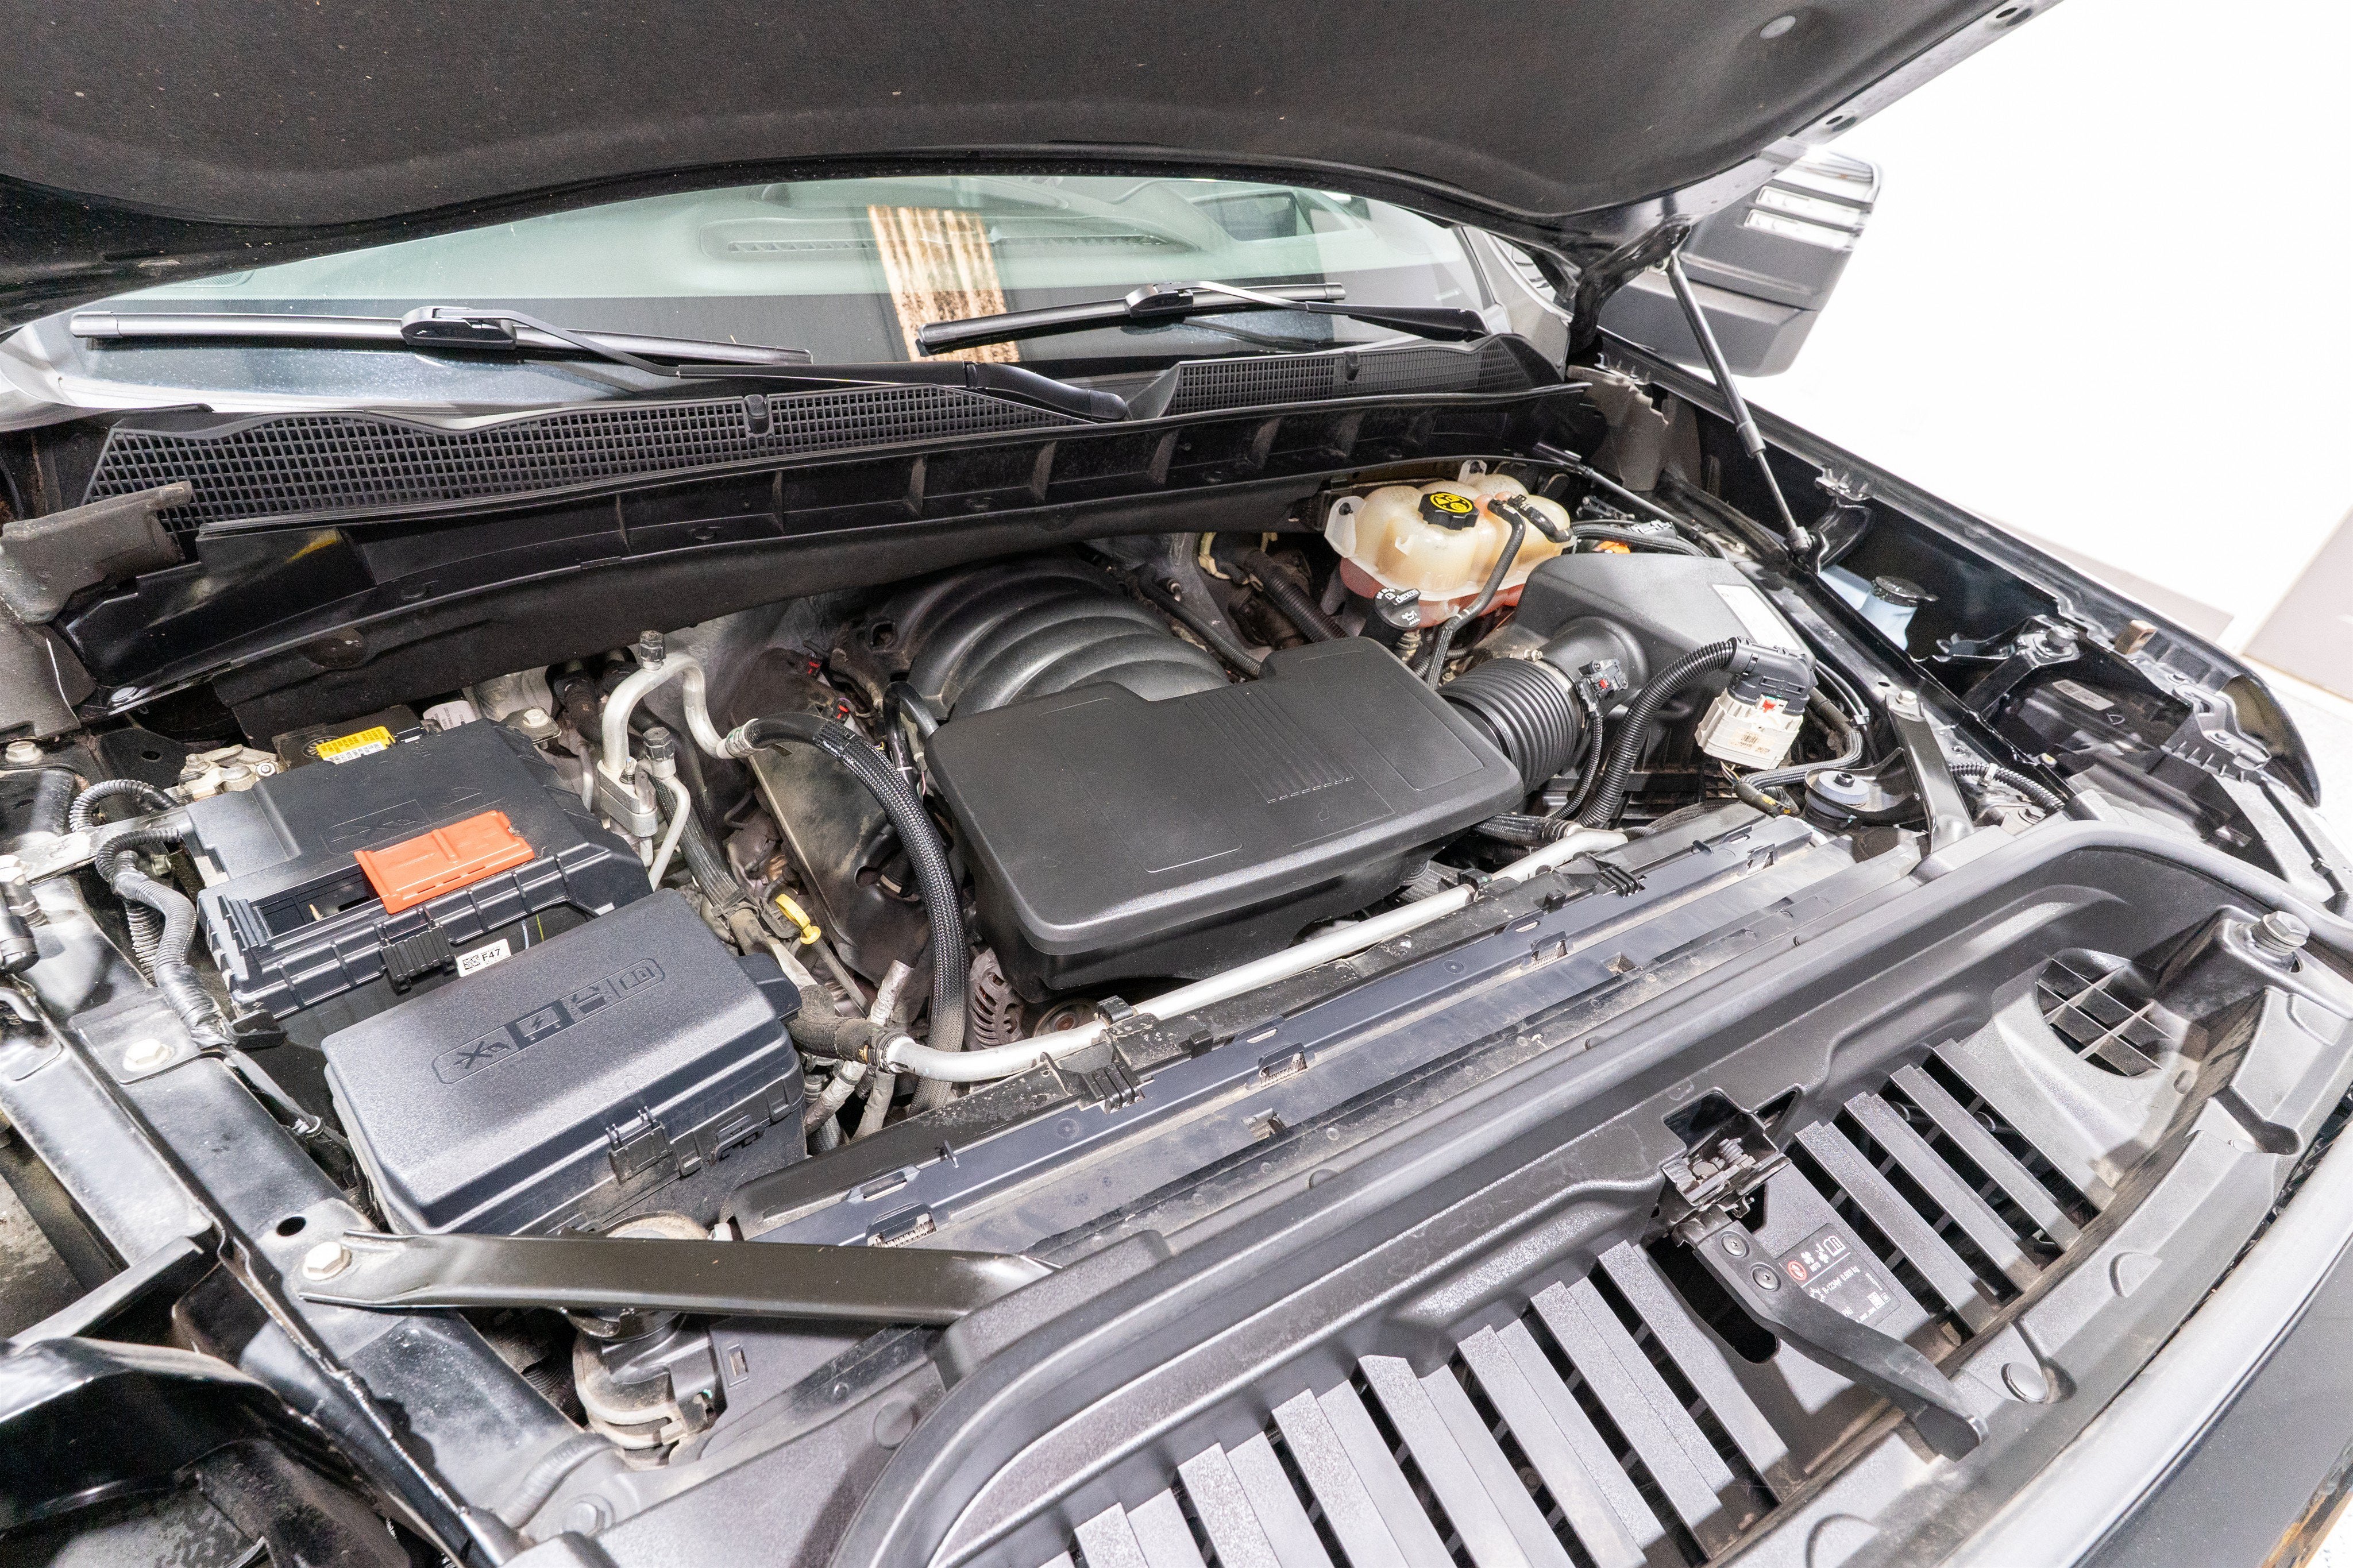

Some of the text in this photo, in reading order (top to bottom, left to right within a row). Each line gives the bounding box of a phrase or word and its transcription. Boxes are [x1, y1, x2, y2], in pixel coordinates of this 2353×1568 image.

[1395, 589, 1419, 604] dexos
[482, 948, 500, 961] F47
[1810, 1261, 1822, 1272] AUTO
[1841, 1306, 1854, 1318] PAG
